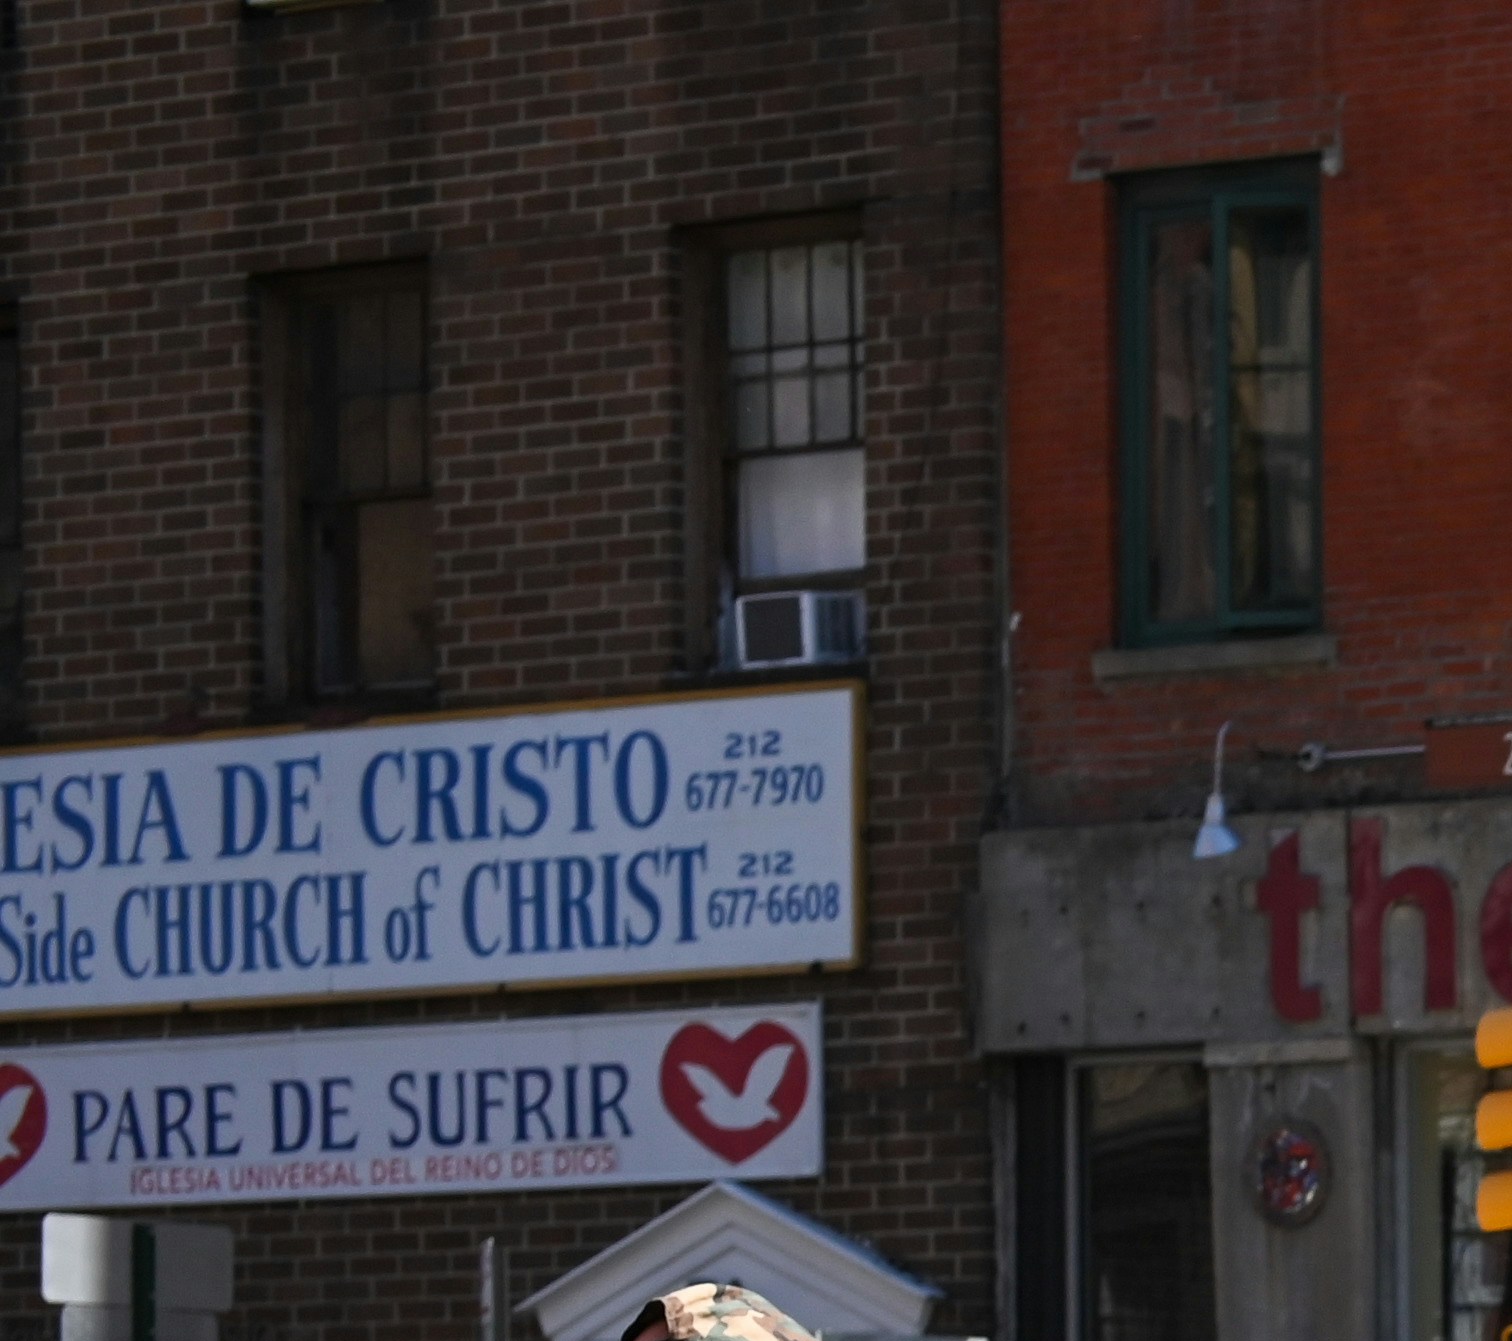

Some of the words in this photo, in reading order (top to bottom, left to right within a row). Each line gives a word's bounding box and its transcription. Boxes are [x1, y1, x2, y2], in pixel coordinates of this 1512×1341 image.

[723, 730, 783, 760] 212
[1, 768, 191, 875] ESIA
[215, 752, 322, 858] DE
[359, 729, 670, 849] CRISTO
[685, 763, 825, 812] 677-7970
[738, 851, 794, 878] 212
[0, 891, 96, 989] Side
[113, 871, 370, 980] CHURCH
[384, 864, 440, 964] of
[462, 842, 708, 958] CHRIST
[708, 882, 841, 930] 677-6608
[73, 1081, 243, 1164] PARE
[271, 1077, 358, 1154] DE
[387, 1063, 633, 1149] SUFRIR
[130, 1165, 221, 1196] IGLESIA
[228, 1158, 362, 1192] UNIVERSAL
[369, 1157, 416, 1186] DEL
[425, 1151, 501, 1183] REINO
[511, 1149, 543, 1179] DE
[554, 1144, 617, 1177] DIOS
